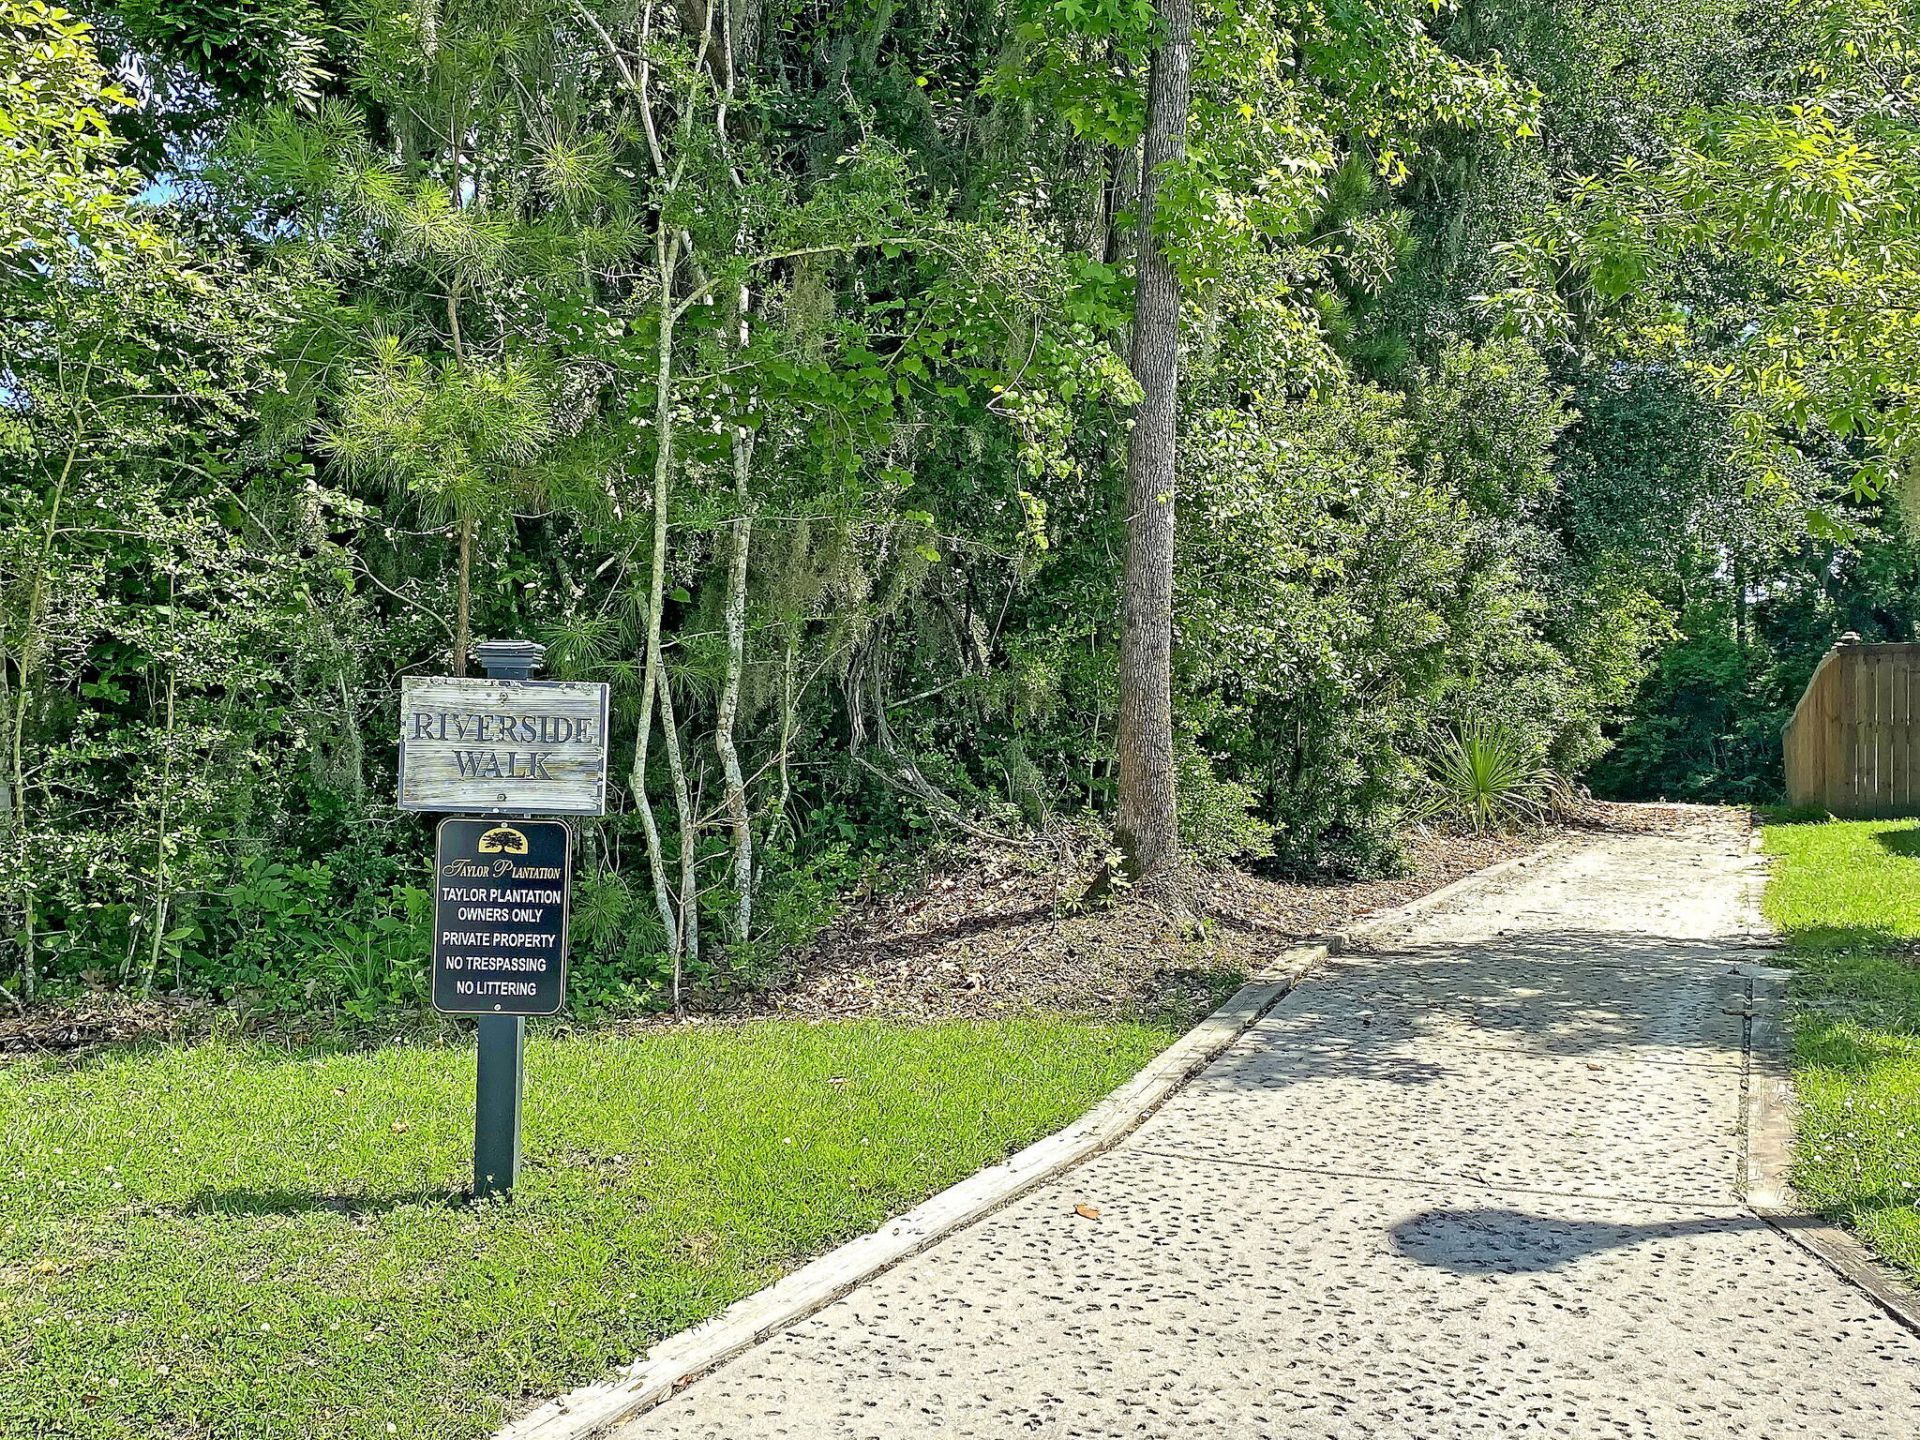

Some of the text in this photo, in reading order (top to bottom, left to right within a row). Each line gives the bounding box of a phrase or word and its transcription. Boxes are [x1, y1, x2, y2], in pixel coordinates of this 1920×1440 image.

[411, 712, 593, 744] RIVERSIDE
[452, 749, 553, 780] WALK
[442, 887, 561, 904] TAYLOR PLANTATION
[457, 907, 543, 923] OWNERS ONLY
[442, 931, 556, 948] PRIVATE PROPERTY
[445, 956, 547, 972] NO TRESPASSING
[456, 981, 537, 996] NO LITTERING
